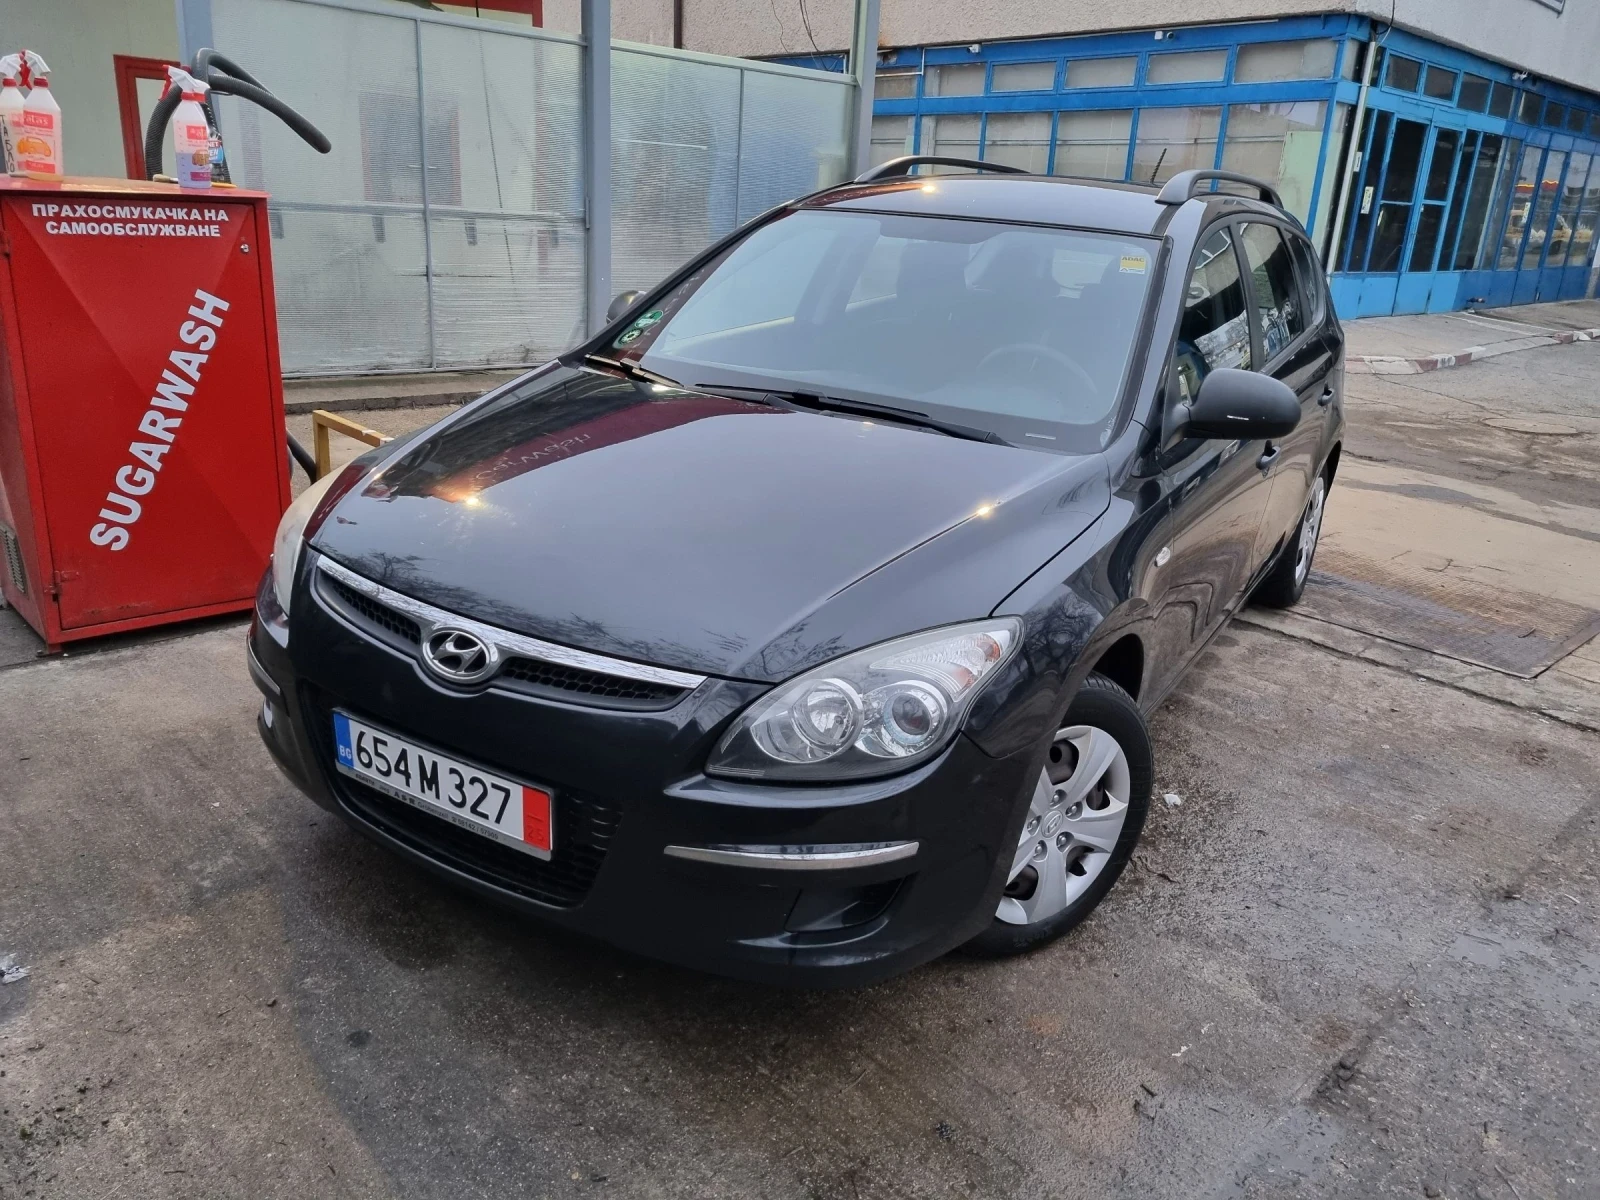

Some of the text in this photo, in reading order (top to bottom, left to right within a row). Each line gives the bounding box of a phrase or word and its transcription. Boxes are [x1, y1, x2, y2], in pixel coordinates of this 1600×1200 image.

[31, 203, 229, 222] ПРАХОСМУКАЧКА НА
[45, 221, 221, 237] САМООБСЛУЖВАНЕ
[89, 288, 230, 551] SUGARWASH
[339, 744, 352, 760] BG
[356, 730, 511, 825] 654 M 327
